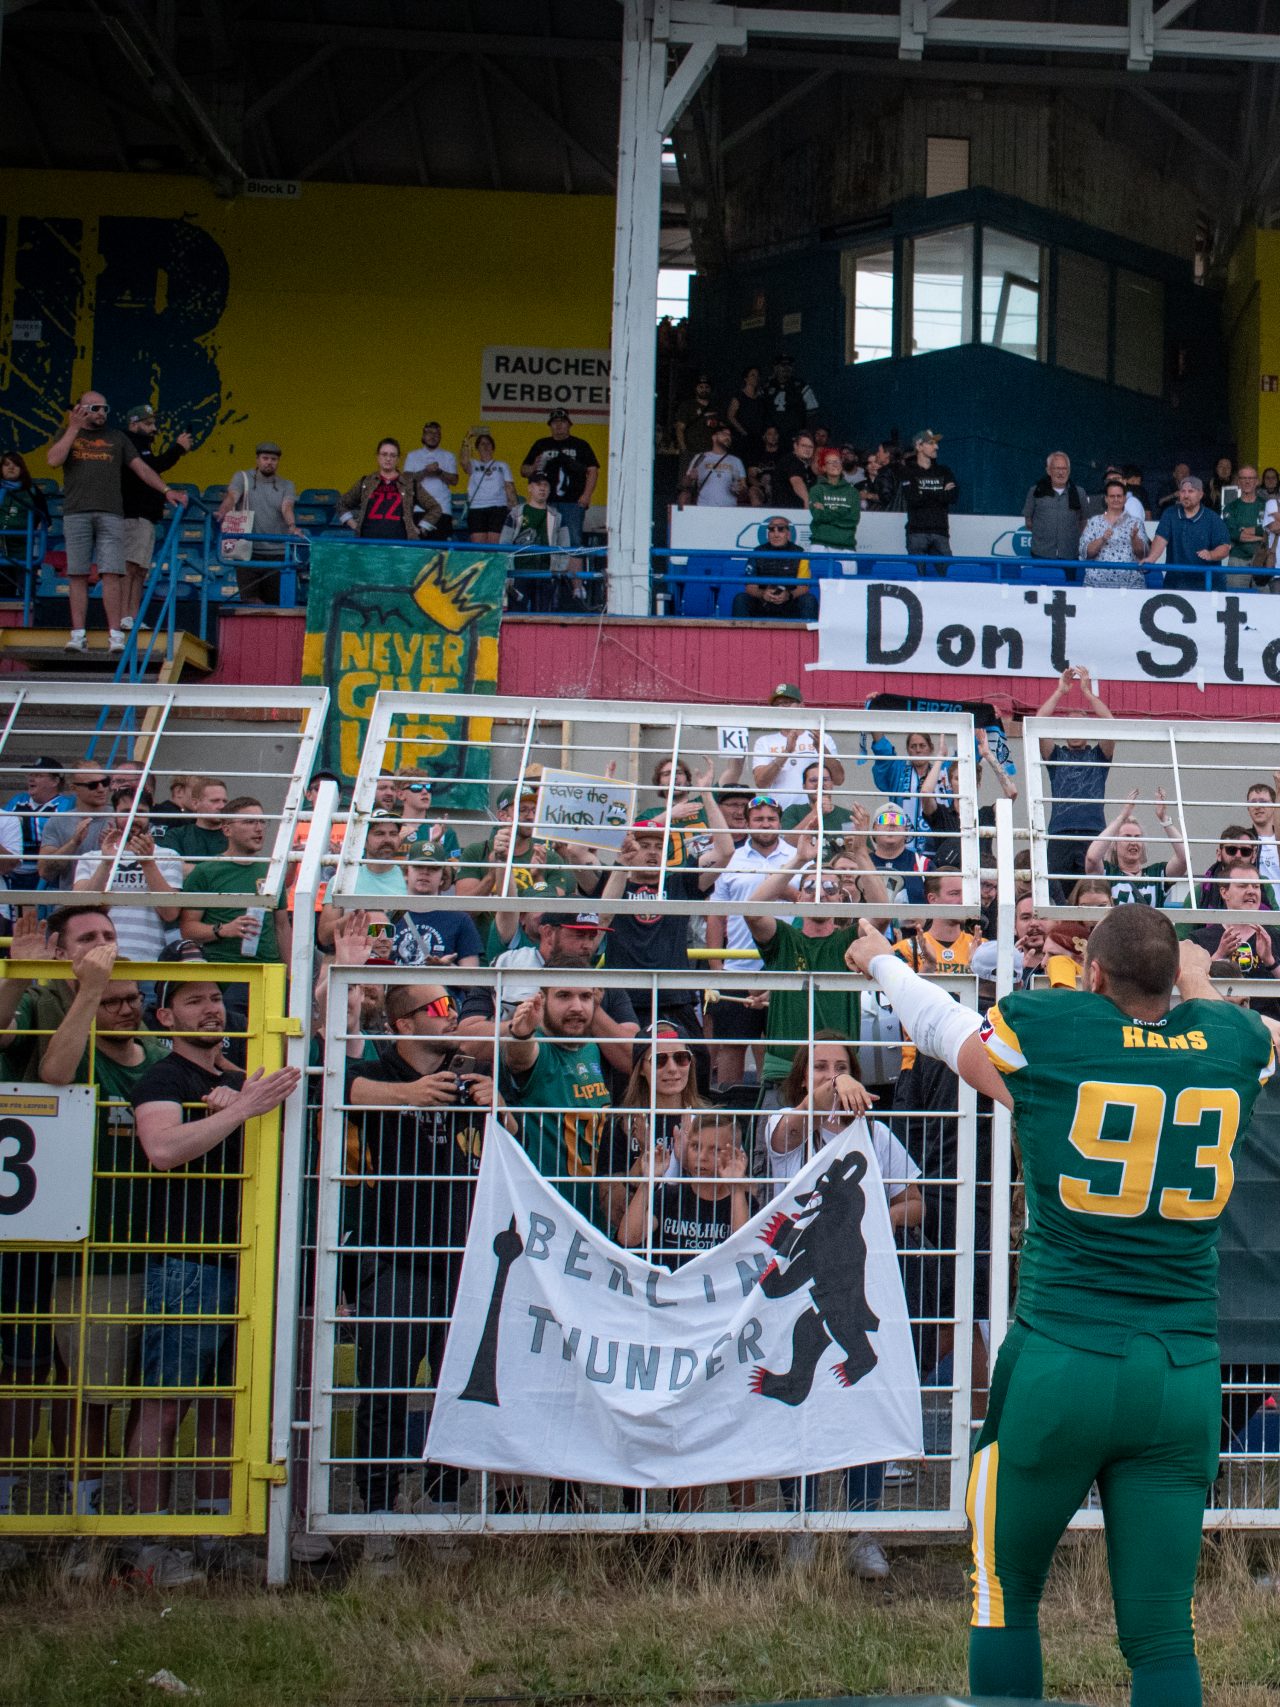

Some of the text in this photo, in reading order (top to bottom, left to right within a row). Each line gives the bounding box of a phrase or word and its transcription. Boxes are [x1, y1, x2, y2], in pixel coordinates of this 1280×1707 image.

[495, 355, 610, 377] RAUCHEN
[367, 491, 401, 521] 22
[866, 583, 1077, 674] Don't
[340, 632, 465, 675] NEVER
[1121, 1025, 1208, 1050] HANS
[1058, 1080, 1241, 1221] 93
[525, 1211, 769, 1309] BERLIN
